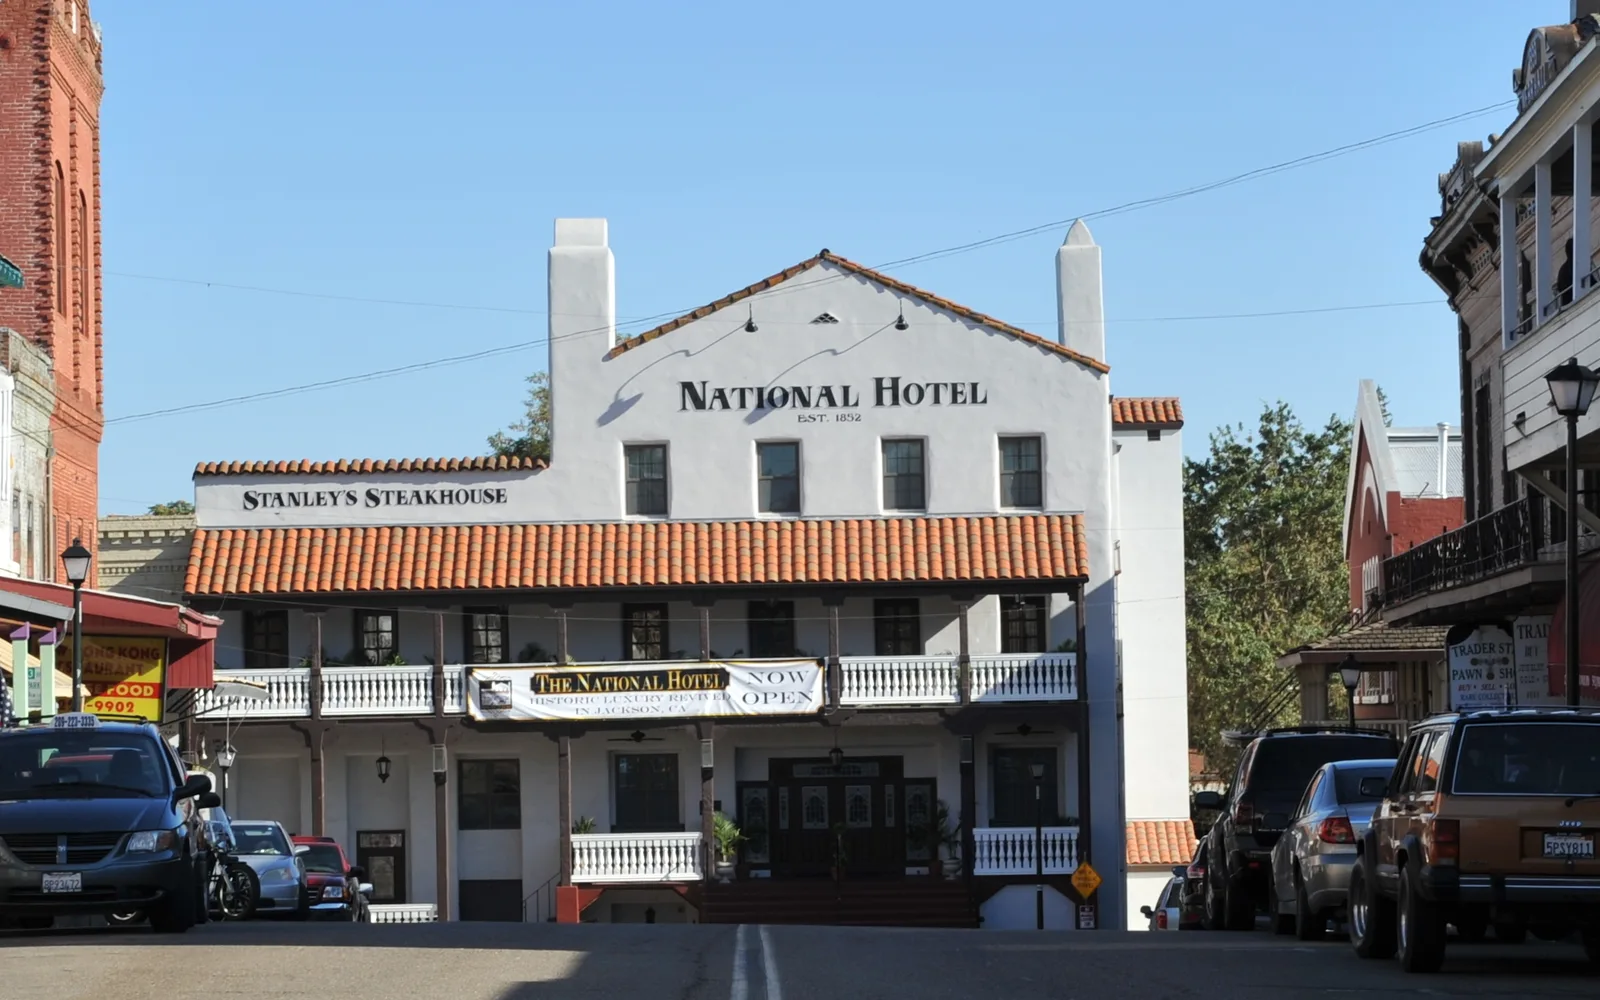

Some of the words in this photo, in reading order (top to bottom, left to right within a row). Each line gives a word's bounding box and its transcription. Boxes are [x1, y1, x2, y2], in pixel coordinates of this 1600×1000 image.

[678, 380, 859, 412] NATIONAL
[872, 376, 988, 408] HOTEL
[797, 413, 830, 423] EST.
[835, 413, 862, 423] 1852
[243, 490, 358, 510] STANLEY'S
[364, 488, 508, 508] STEAKHOUSE
[117, 645, 161, 661] KONG
[1452, 642, 1496, 658] TRADER
[747, 670, 810, 685] NOW
[1452, 668, 1483, 680] PAWN
[536, 674, 572, 693] THE
[576, 672, 664, 692] NATIONAL
[667, 670, 725, 690] HOTEL
[1481, 683, 1495, 691] SELL
[107, 684, 154, 696] FOOD
[530, 696, 599, 705] HISTORIC
[603, 694, 664, 704] LUXURY
[669, 691, 731, 702] REVIVED
[742, 691, 814, 705] OPEN
[575, 707, 590, 715] IN
[594, 705, 664, 715] JACKSON,
[669, 705, 687, 713] CA
[1546, 842, 1590, 855] 5PSY811
